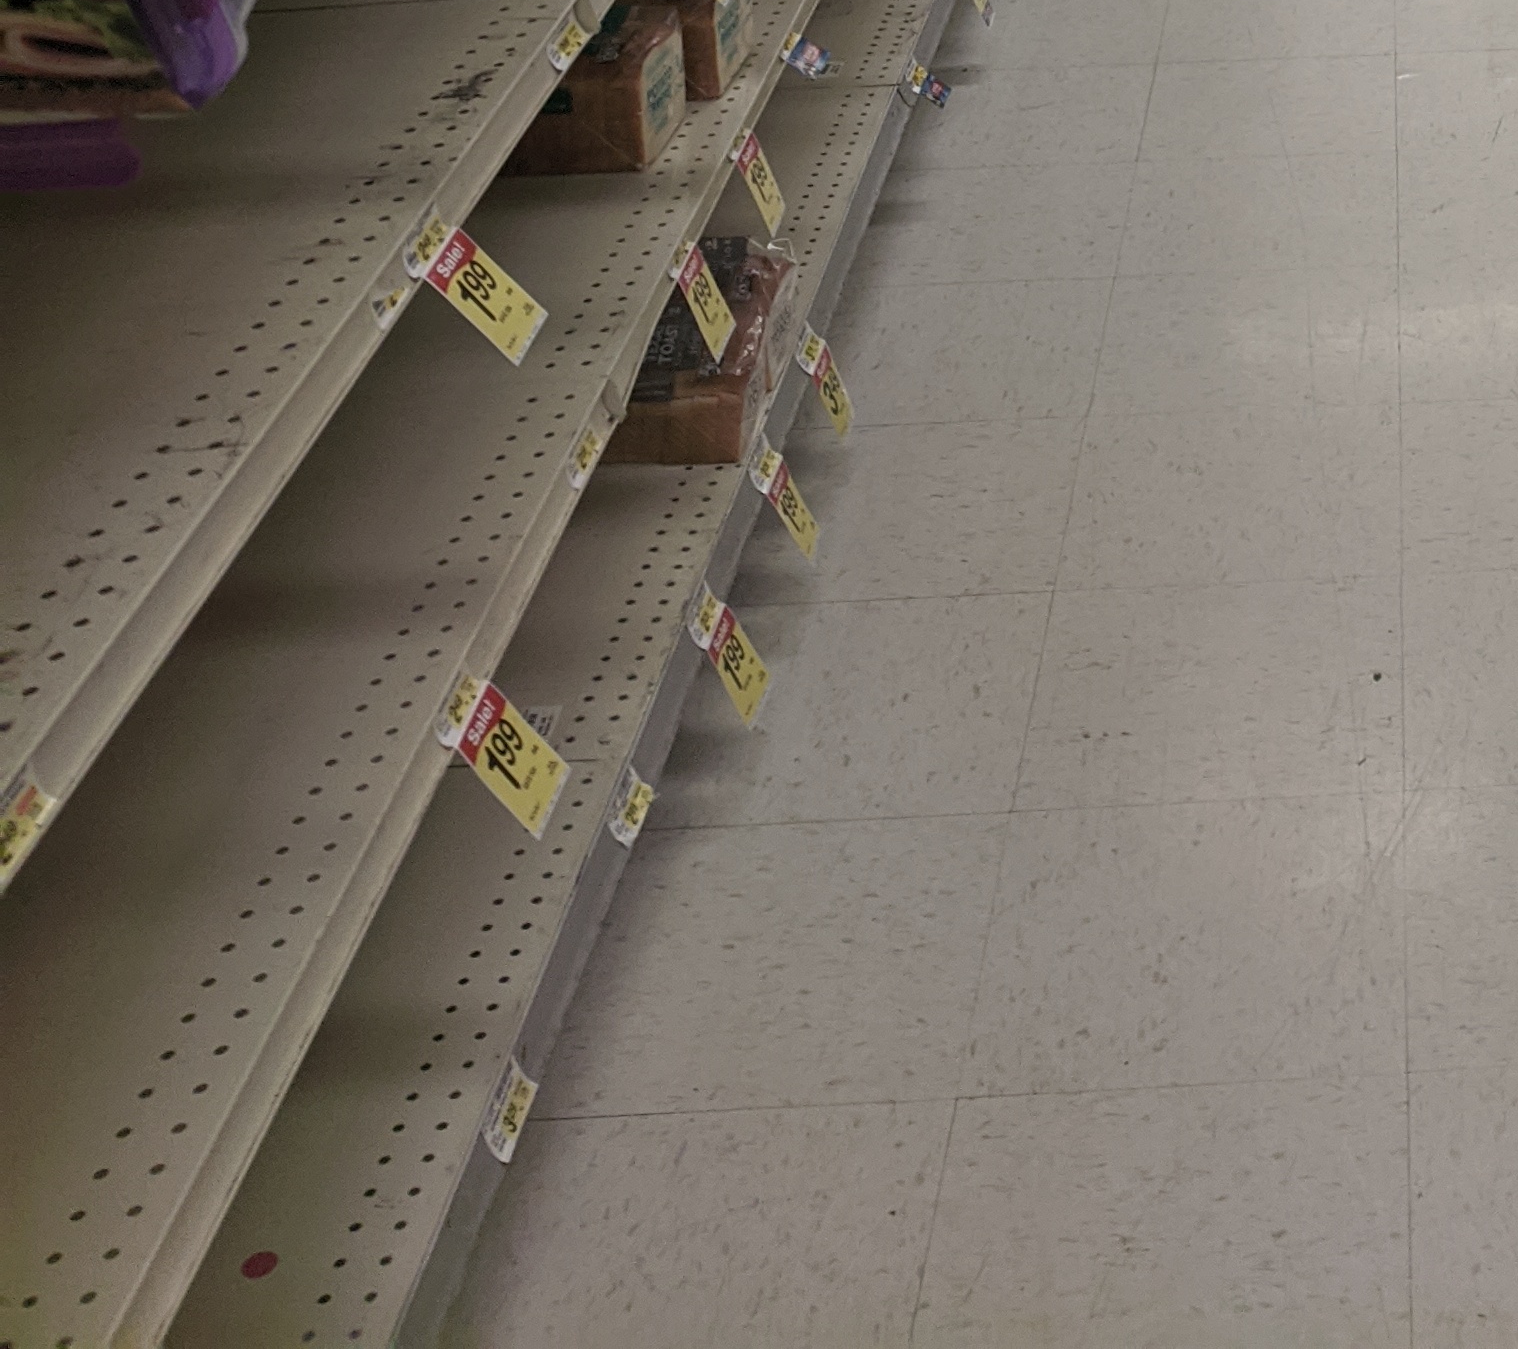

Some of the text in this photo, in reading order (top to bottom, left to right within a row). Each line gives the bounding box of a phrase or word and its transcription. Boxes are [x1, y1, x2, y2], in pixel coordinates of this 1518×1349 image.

[456, 260, 498, 322] 199
[692, 273, 713, 325] 199
[780, 486, 801, 533] 199
[723, 634, 746, 690] 199
[484, 718, 523, 791] 199
